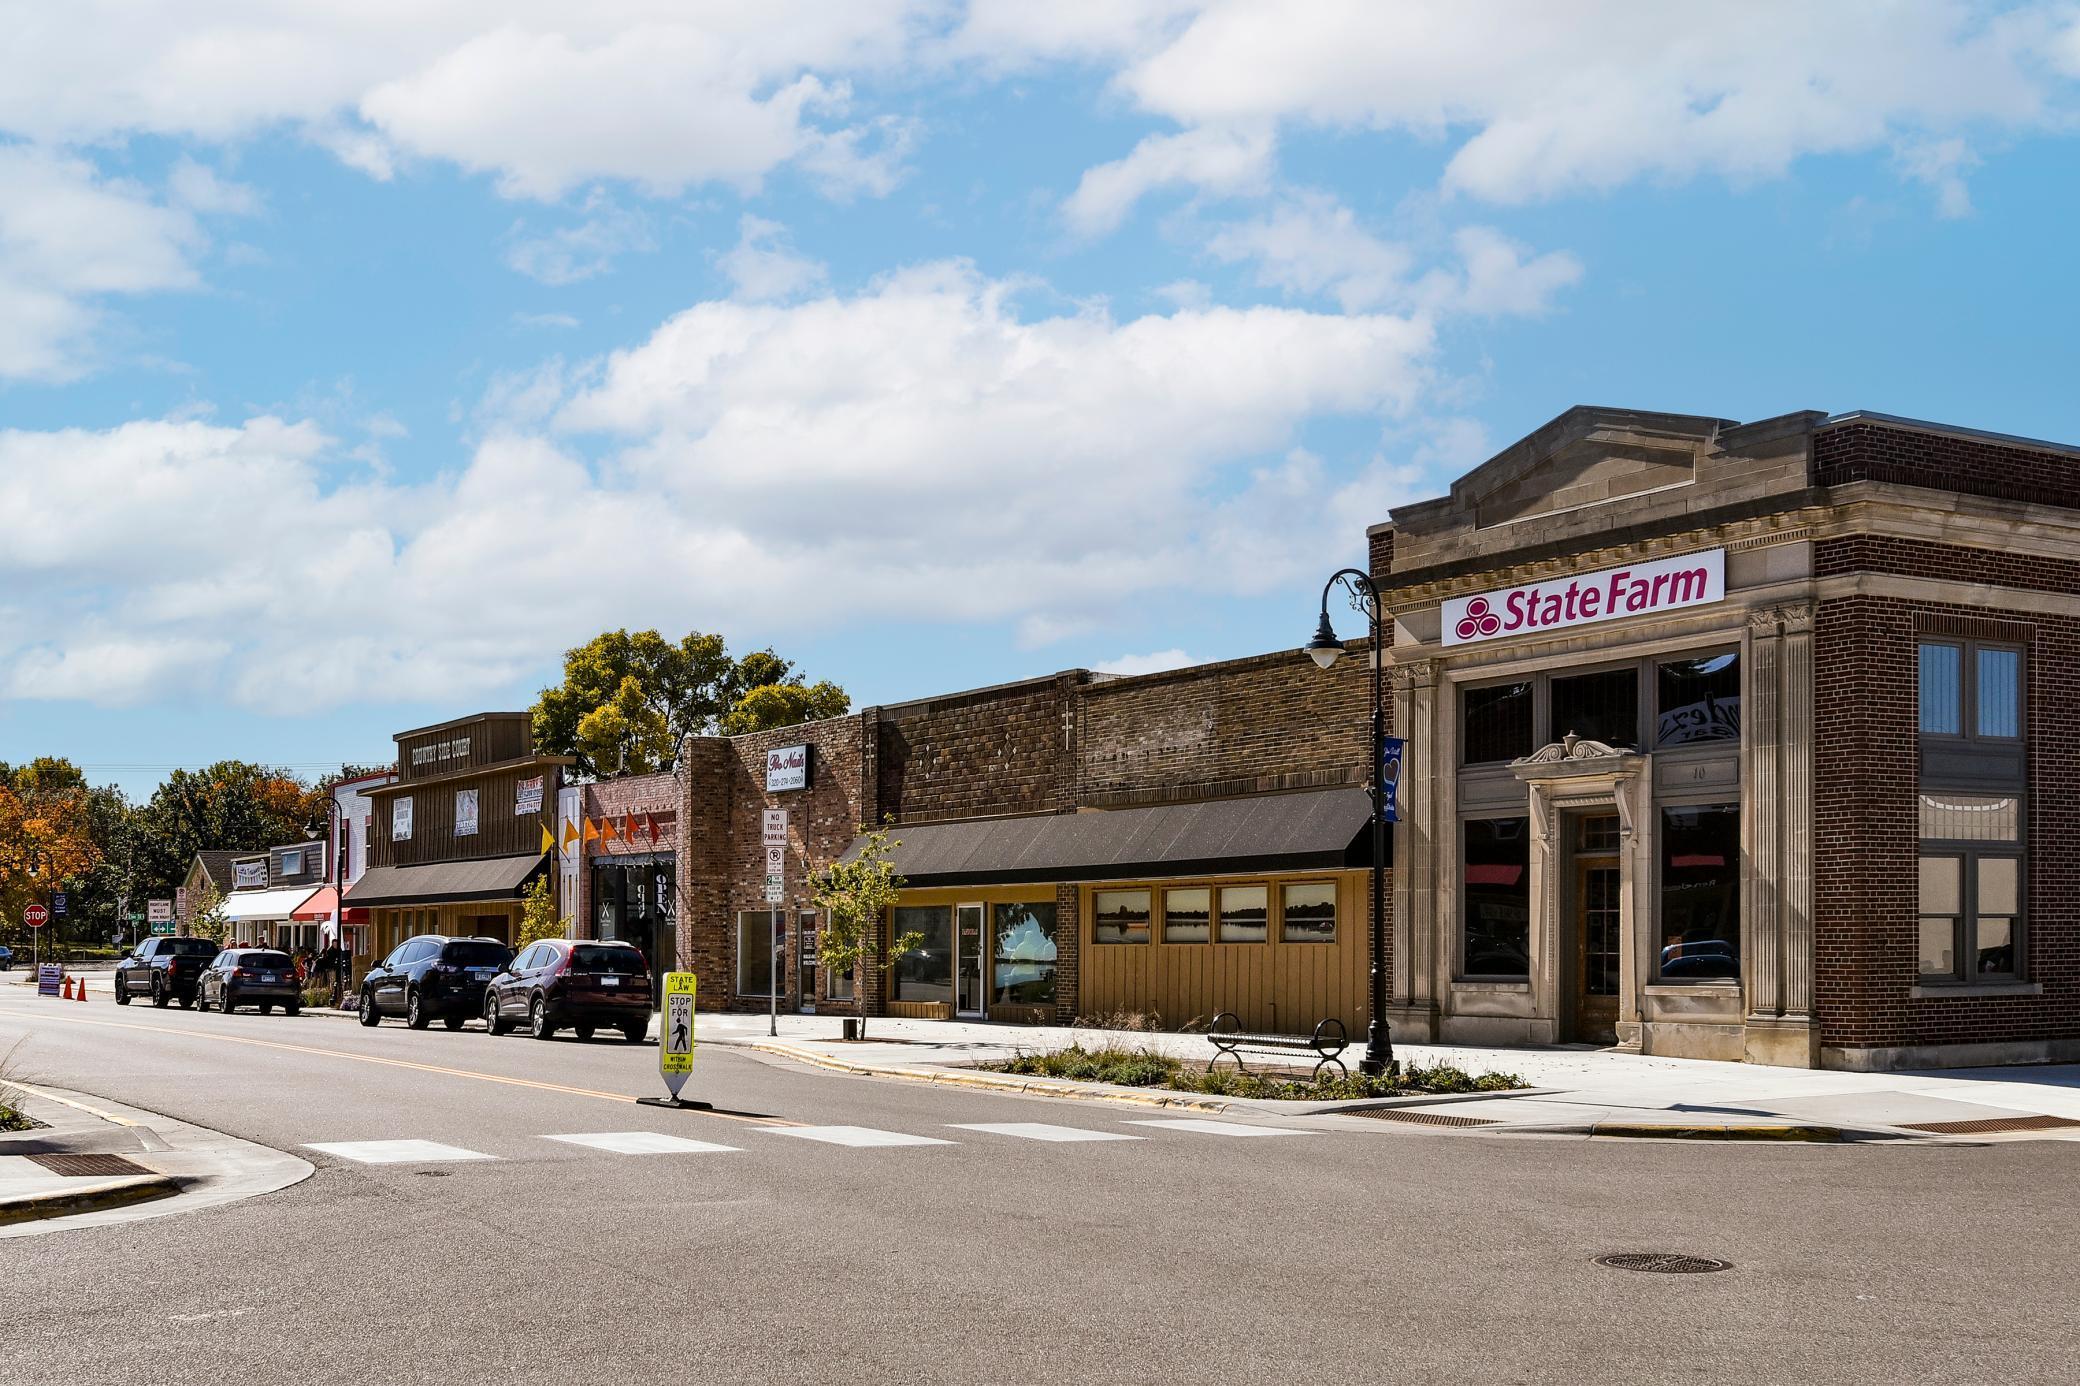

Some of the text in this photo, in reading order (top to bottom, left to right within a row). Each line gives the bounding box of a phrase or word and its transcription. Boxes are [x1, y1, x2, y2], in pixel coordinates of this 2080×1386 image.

[1504, 566, 1708, 631] State Farm
[413, 737, 470, 766] COUNTRY SIDE COURT
[783, 751, 804, 770] Nails
[770, 813, 780, 821] NO
[767, 823, 784, 831] TRUCK
[764, 833, 786, 841] PARKING
[656, 874, 667, 914] OPEN
[25, 911, 46, 920] STOP
[670, 997, 691, 1006] STOP
[672, 1008, 688, 1017] FOR
